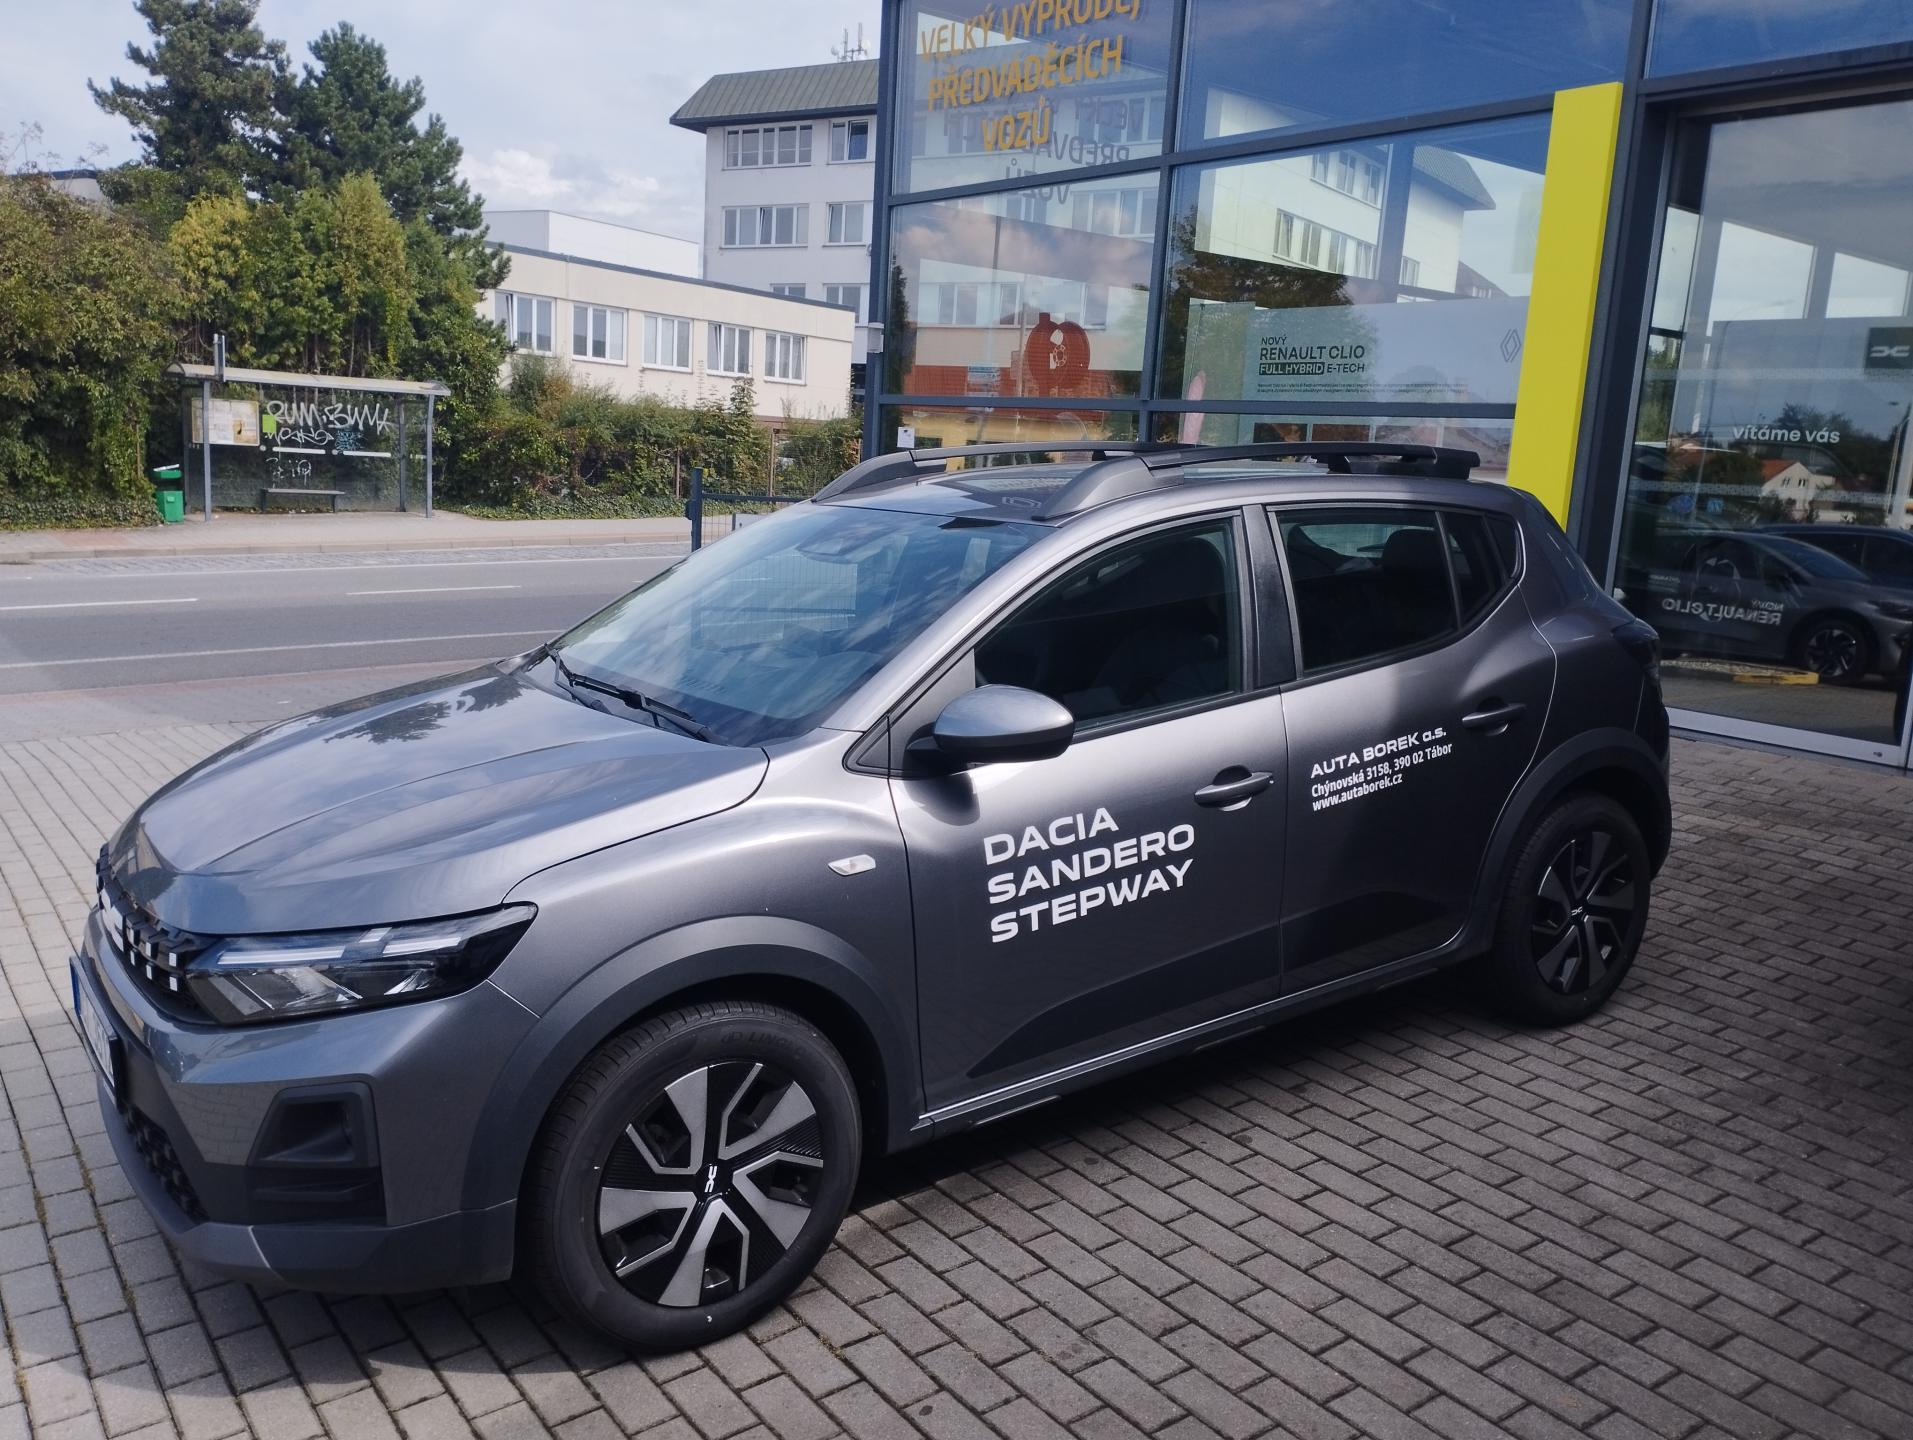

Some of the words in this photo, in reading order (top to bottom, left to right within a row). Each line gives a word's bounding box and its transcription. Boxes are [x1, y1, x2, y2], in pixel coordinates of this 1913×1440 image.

[920, 3, 995, 61] VELKÝ
[981, 95, 1052, 152] VOZŮ
[1259, 345, 1327, 361] RENAULT
[1328, 344, 1366, 360] CLIO
[1261, 333, 1287, 346] NOVÝ
[1259, 363, 1284, 375] FULL
[1285, 362, 1325, 375] HYBRID
[1326, 362, 1366, 374] E-TECH
[1732, 423, 1801, 442] vítáme
[1804, 426, 1841, 444] vás
[1310, 751, 1361, 779] AUTA
[1362, 731, 1420, 763] BOREK
[1422, 727, 1447, 743] a.s.
[1311, 768, 1365, 798] Chýnovská
[1365, 761, 1393, 784] 3158,
[1394, 754, 1411, 771] 390
[1412, 749, 1425, 766] 02
[1425, 742, 1453, 761] Tábor
[1312, 772, 1403, 812] www.autaborek.cz
[983, 807, 1120, 866] DACIA
[987, 823, 1196, 905] SANDERO
[990, 858, 1194, 943] STEPWAY
